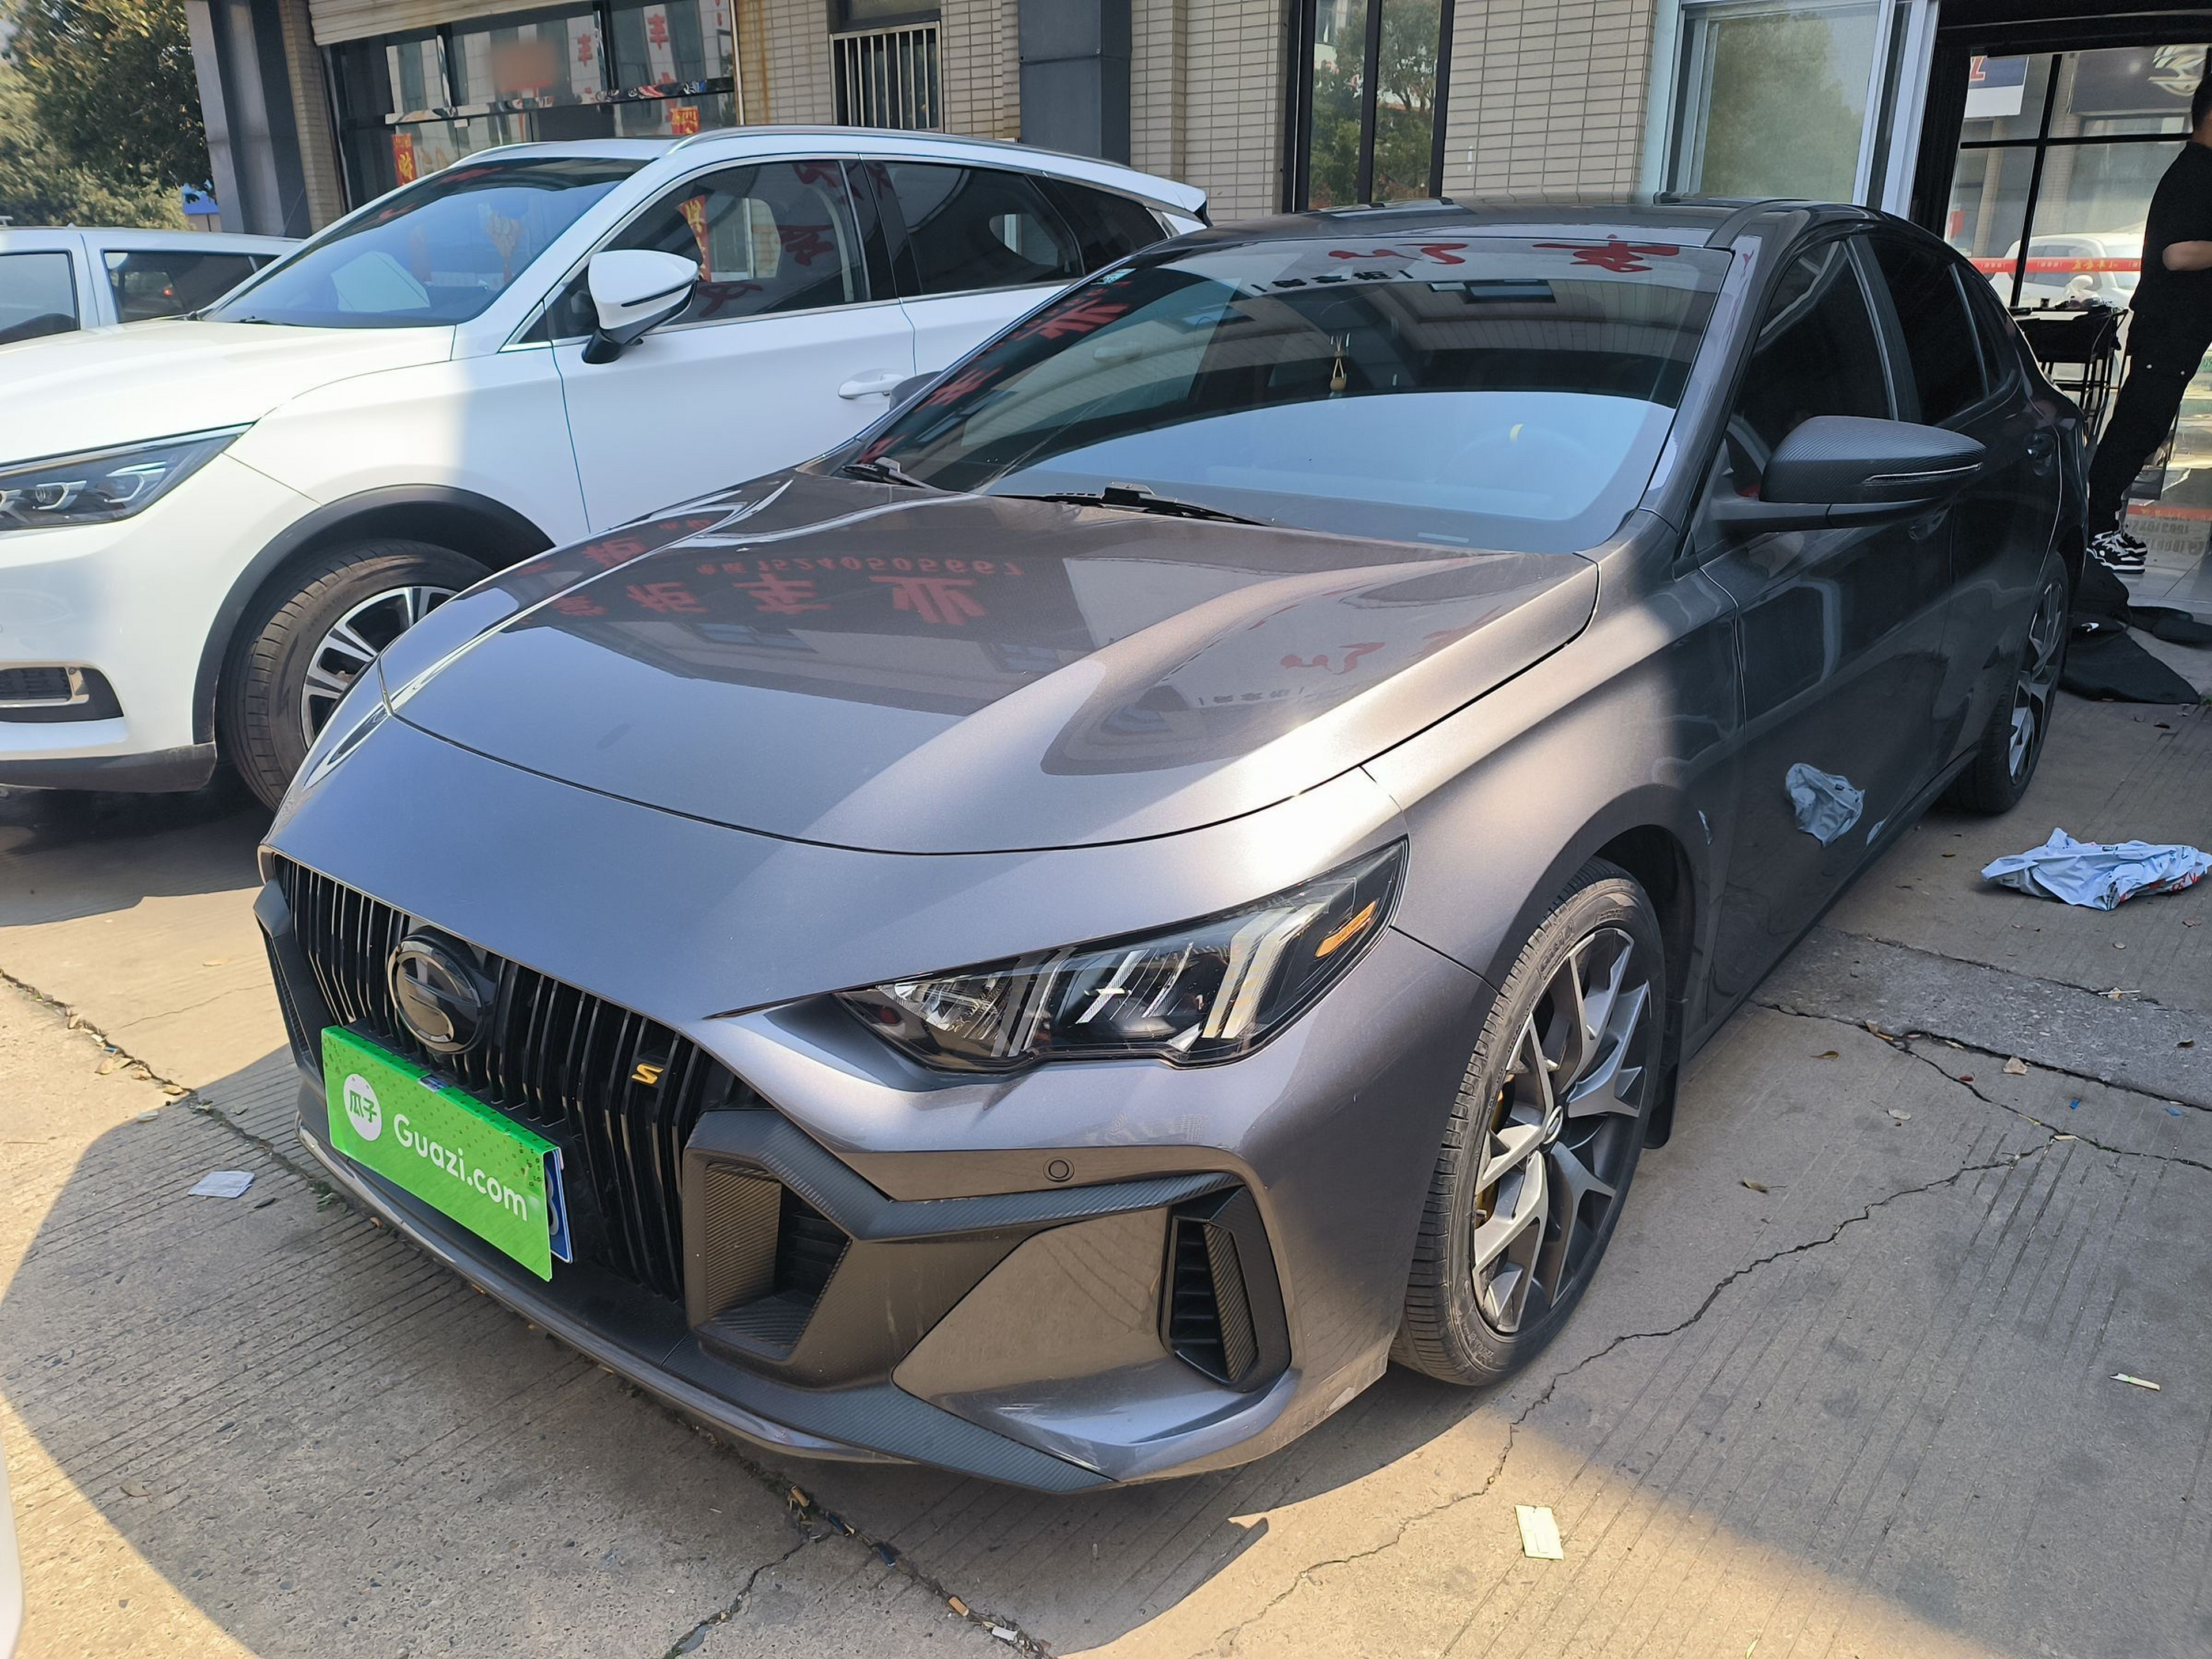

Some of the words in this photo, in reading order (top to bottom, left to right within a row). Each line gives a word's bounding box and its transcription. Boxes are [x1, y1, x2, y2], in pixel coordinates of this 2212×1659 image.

[631, 1063, 664, 1085] S
[349, 1090, 377, 1123] 瓜子
[393, 1113, 528, 1222] Guazi.com
